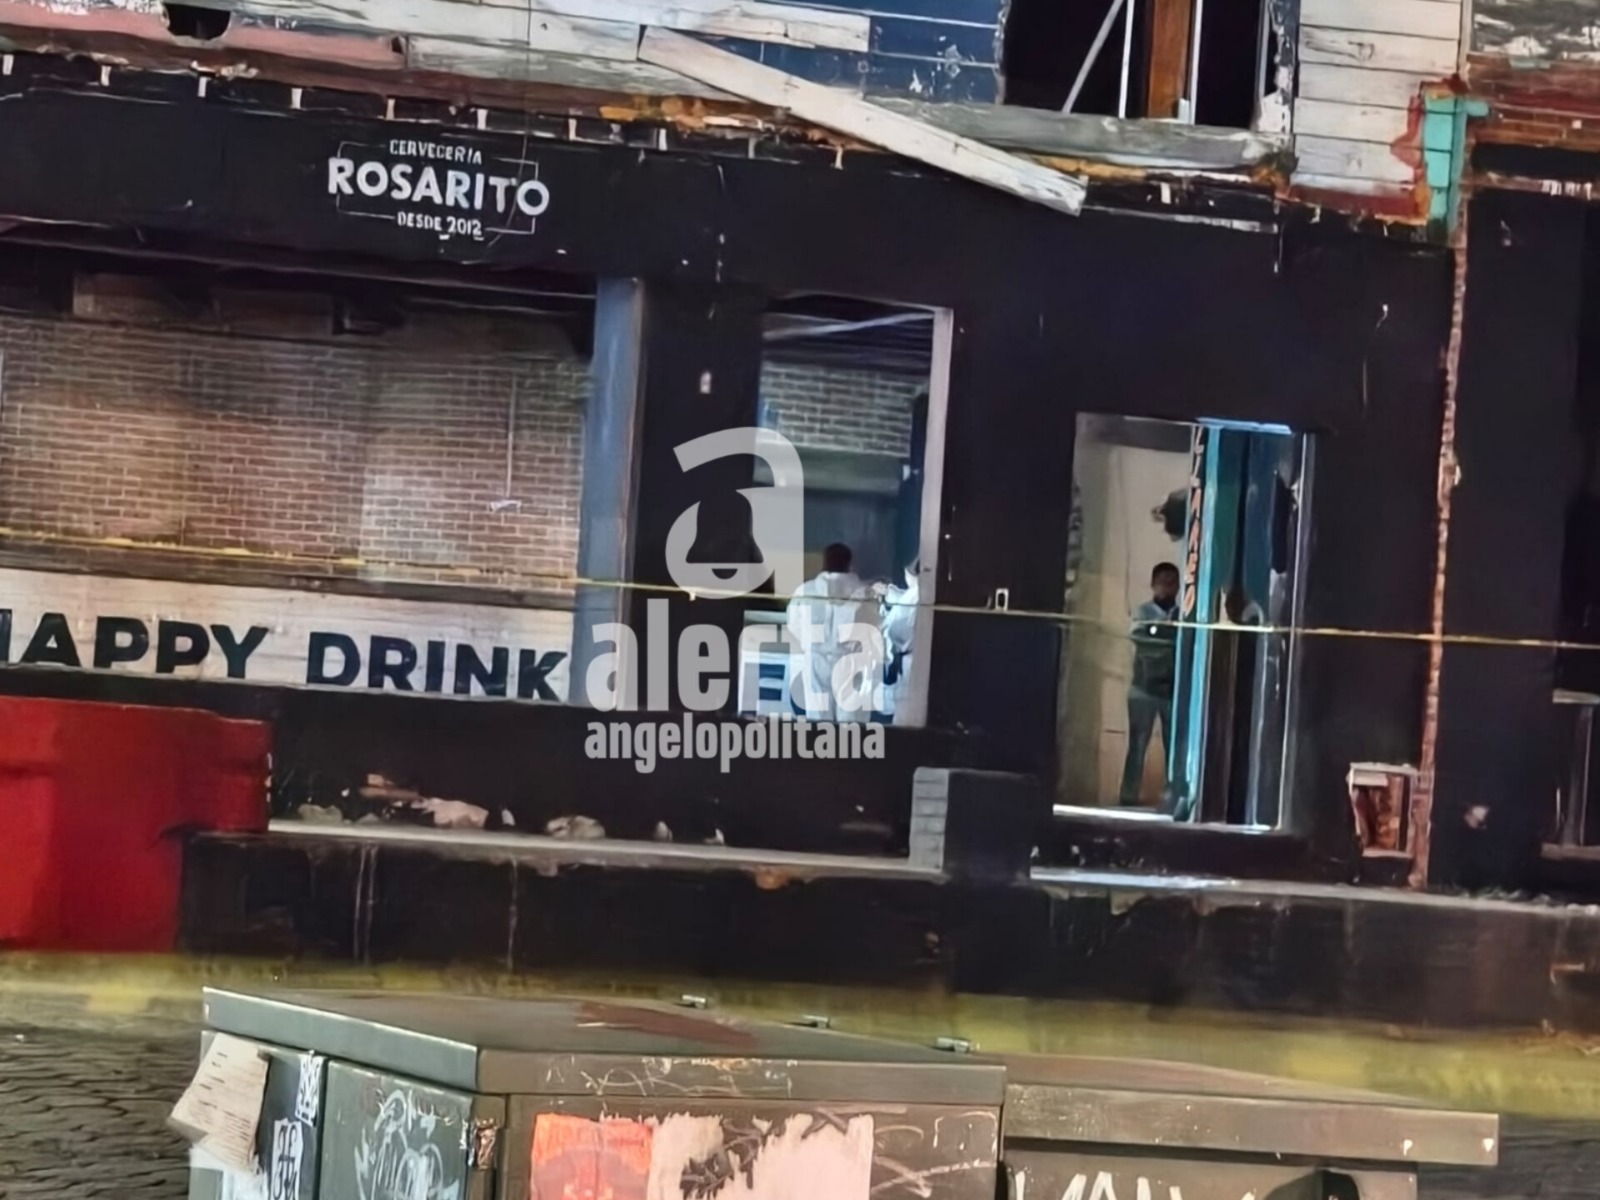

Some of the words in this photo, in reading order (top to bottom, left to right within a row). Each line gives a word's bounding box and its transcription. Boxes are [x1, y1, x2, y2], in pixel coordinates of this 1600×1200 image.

[328, 157, 550, 216] ROSARITO
[397, 211, 441, 230] DESDE
[446, 216, 482, 235] 2012
[0, 609, 269, 679] APPY
[307, 631, 568, 702] DRINK
